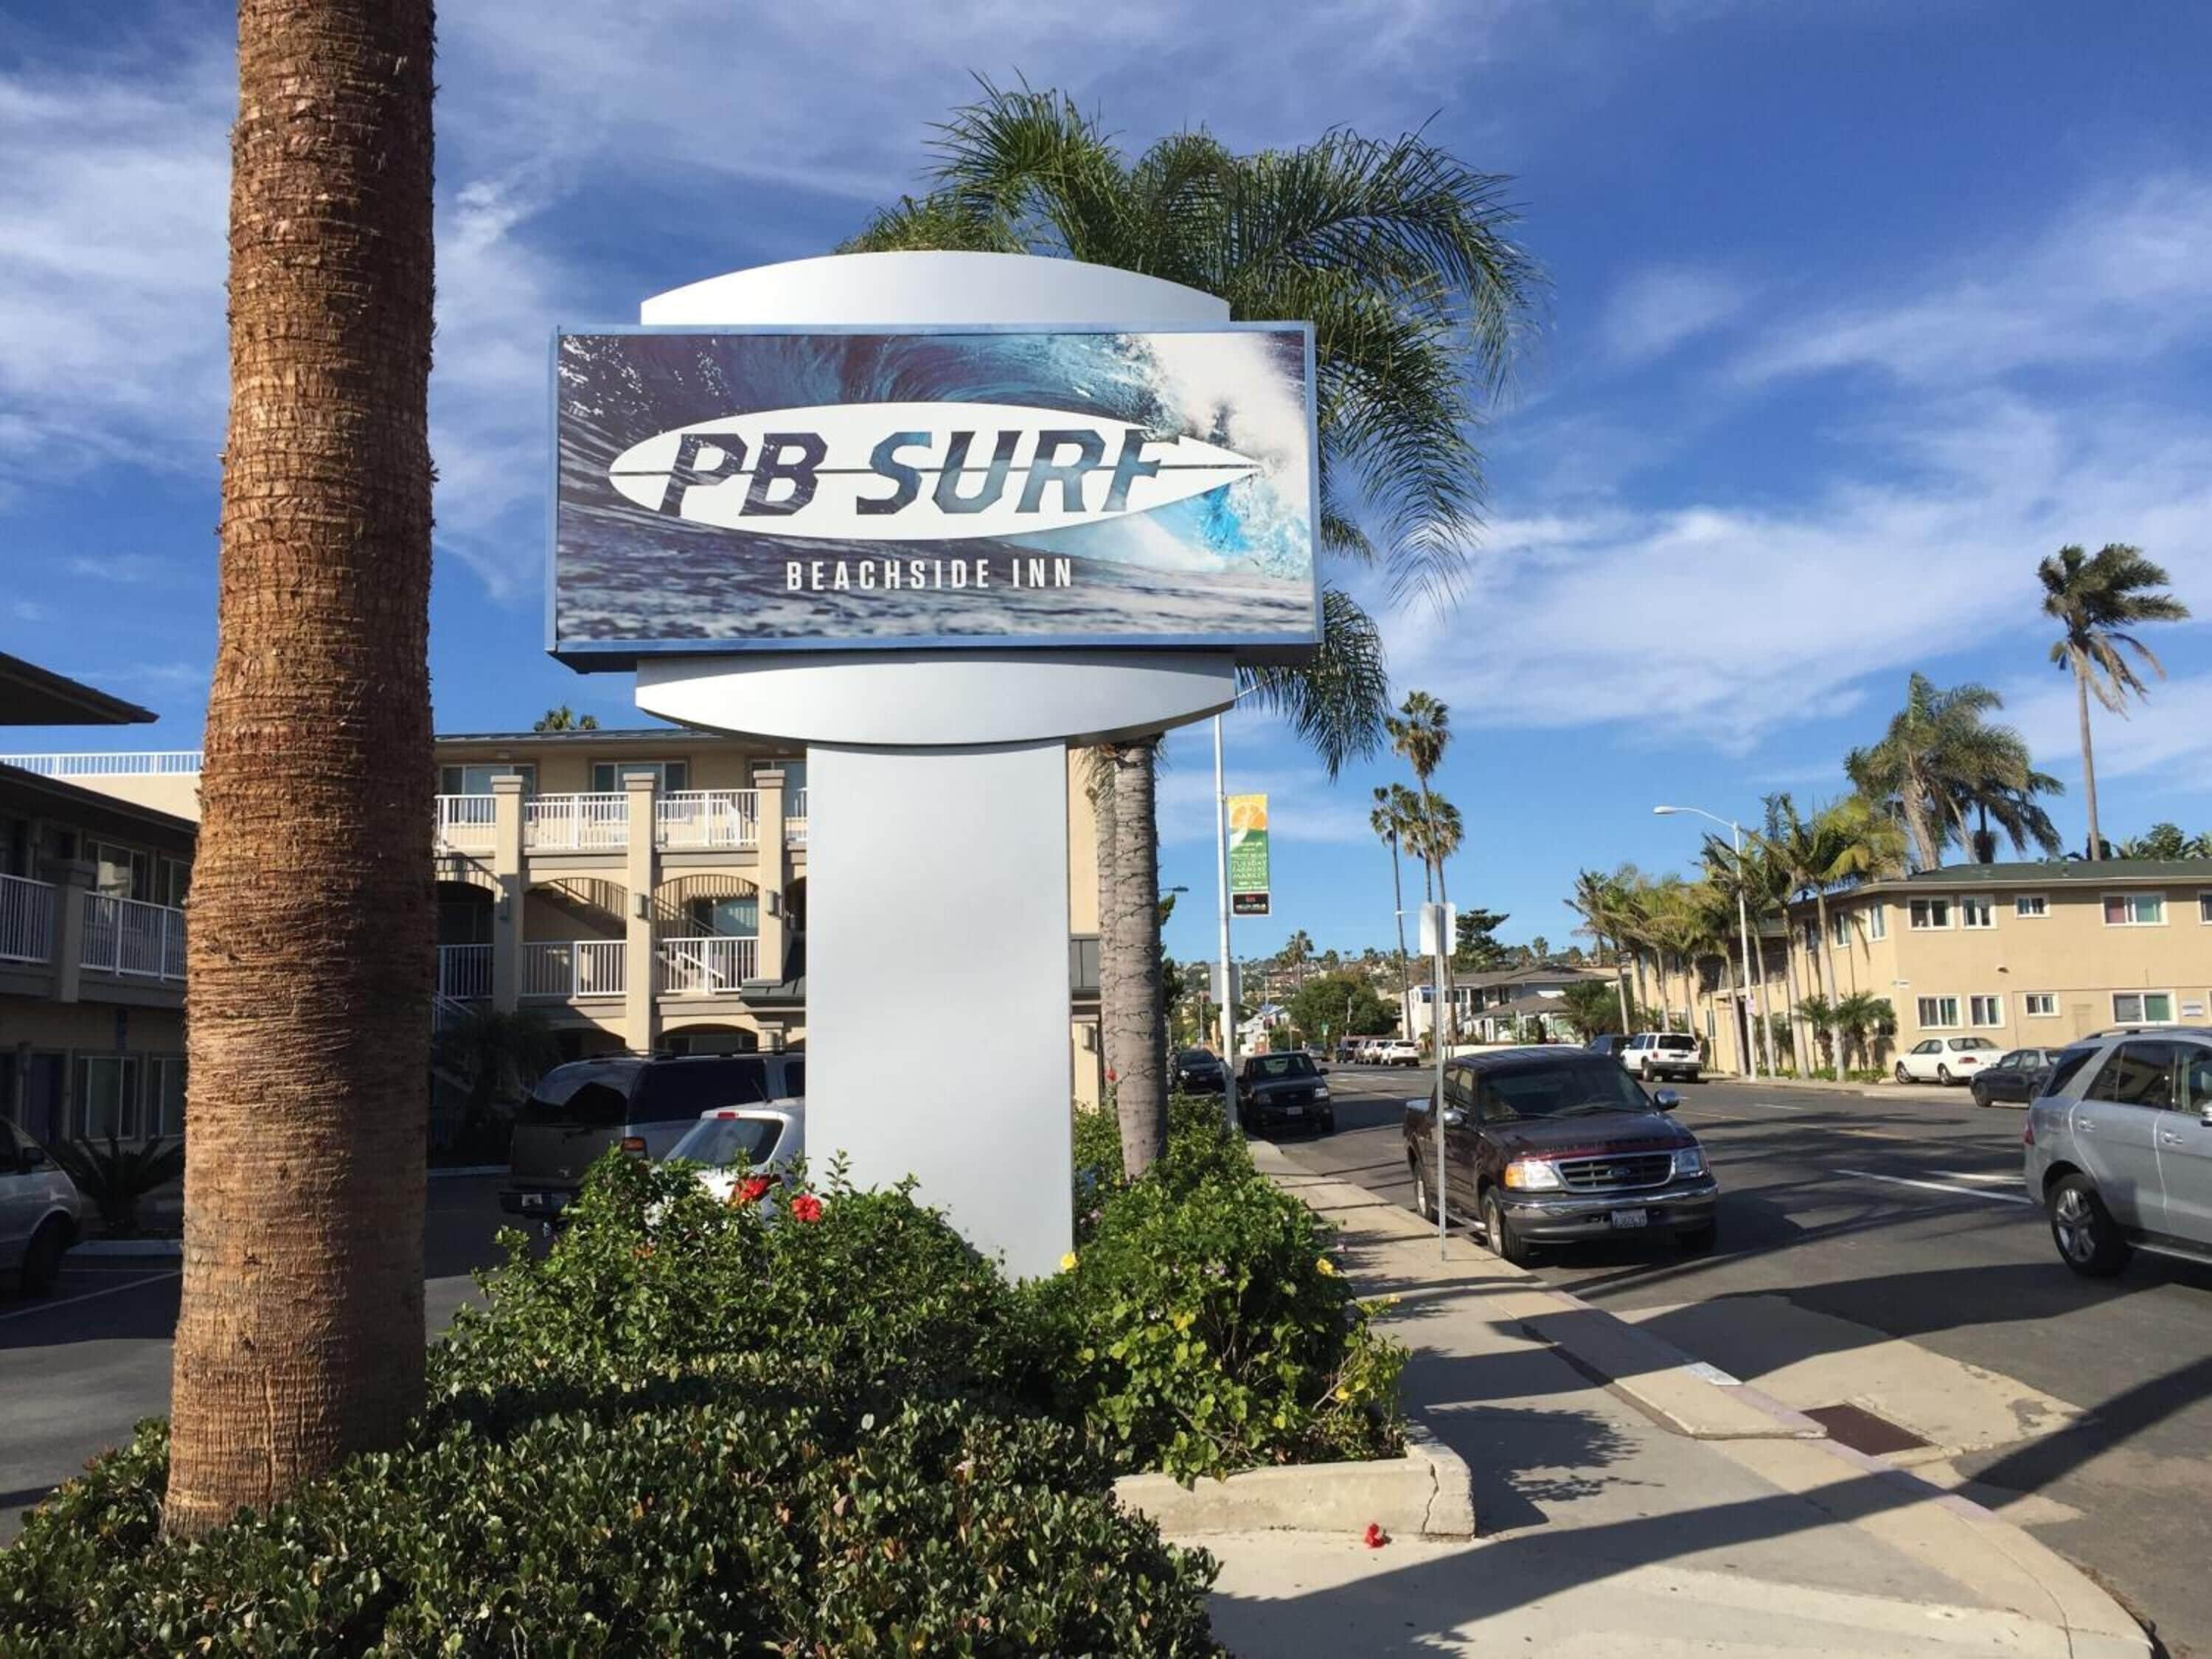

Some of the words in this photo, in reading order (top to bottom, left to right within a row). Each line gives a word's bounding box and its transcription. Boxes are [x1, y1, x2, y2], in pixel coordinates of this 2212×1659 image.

[656, 432, 829, 517] PB
[855, 429, 1180, 515] SURF
[786, 559, 990, 591] BEACHSIDE
[1012, 558, 1072, 588] INN
